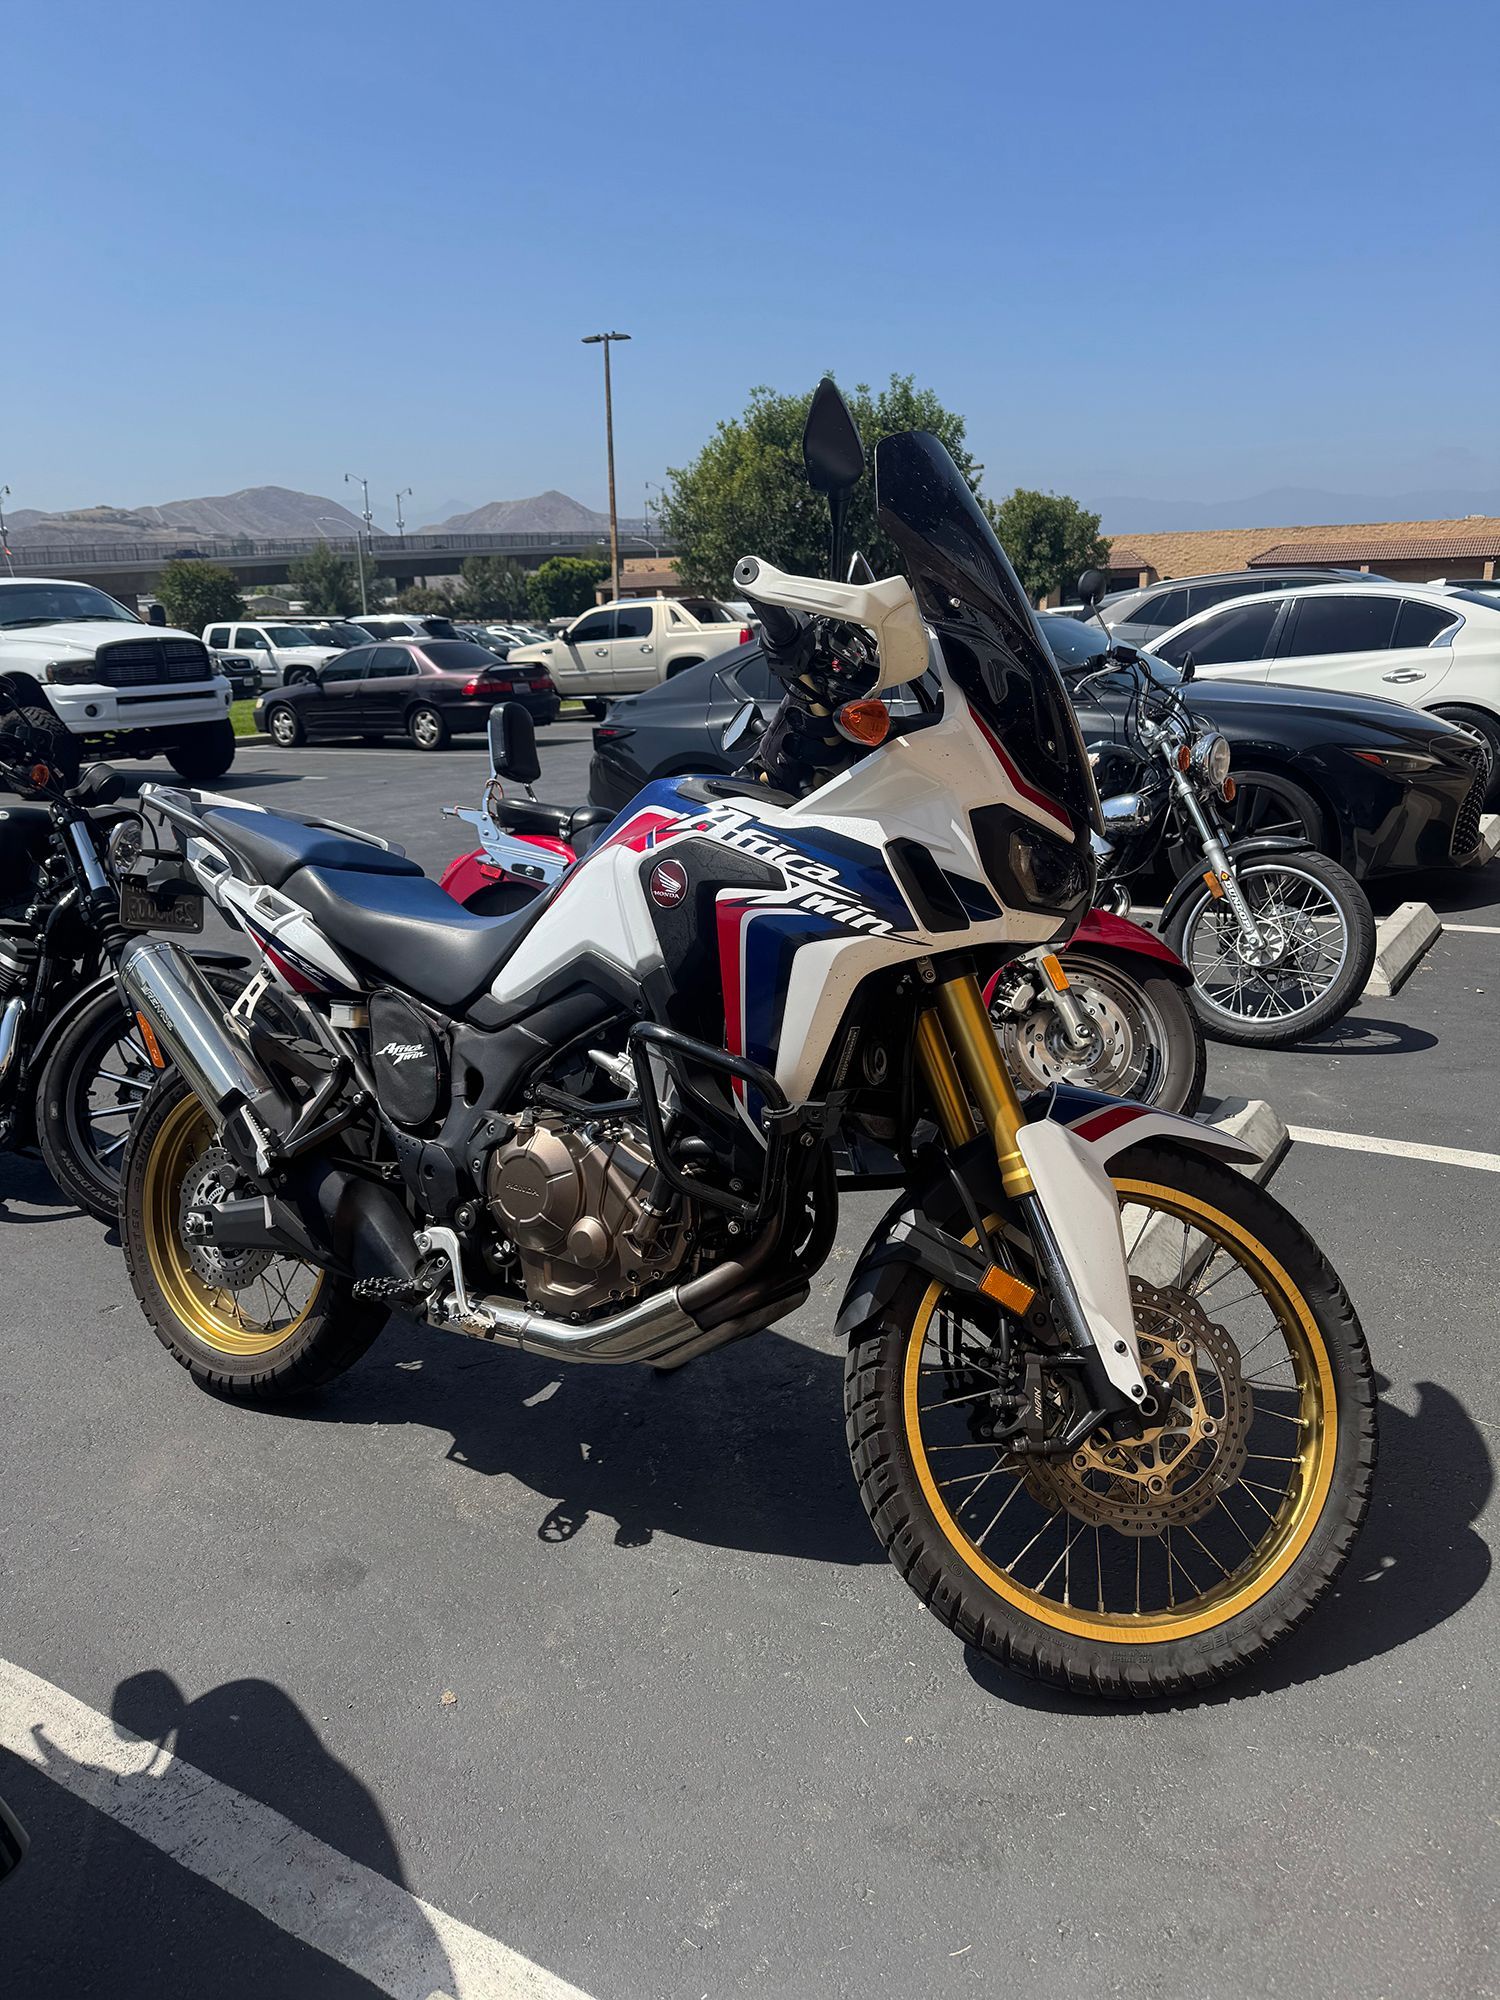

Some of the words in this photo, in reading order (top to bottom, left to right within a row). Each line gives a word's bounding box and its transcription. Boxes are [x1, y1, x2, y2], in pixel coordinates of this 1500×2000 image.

[668, 806, 862, 897] Africa
[653, 890, 681, 900] HONDA
[747, 872, 918, 945] Twin
[1223, 880, 1253, 928] DUNLOP
[375, 1042, 425, 1056] Africa
[393, 1051, 428, 1066] Twin
[134, 1111, 162, 1174] SHINKO
[62, 1156, 118, 1208] DAVIDSON
[505, 1181, 540, 1198] HONDA
[131, 1207, 149, 1275] MASTER
[1289, 1525, 1337, 1592] TRAIL
[1199, 1586, 1290, 1653] MASTER
